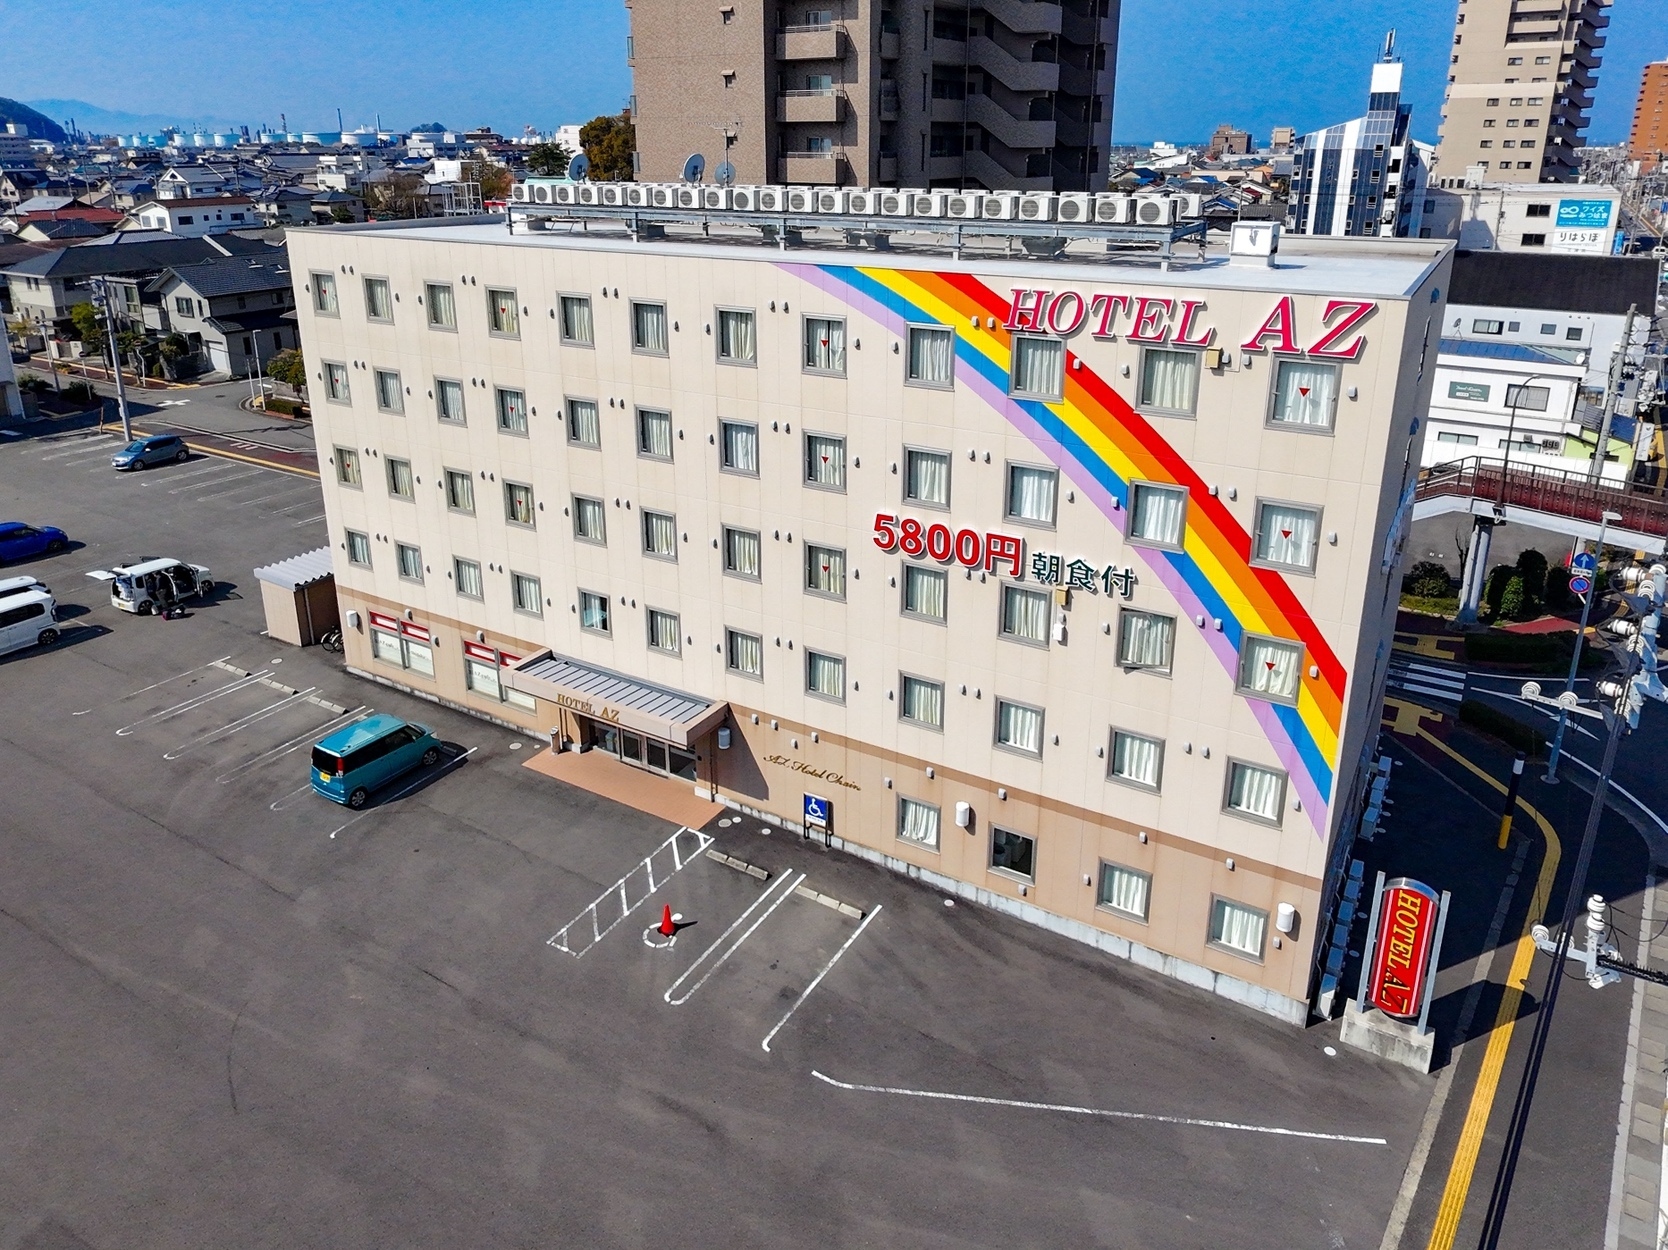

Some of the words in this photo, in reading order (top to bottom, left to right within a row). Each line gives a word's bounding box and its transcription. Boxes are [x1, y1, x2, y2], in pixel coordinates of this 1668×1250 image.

[1560, 232, 1600, 242] りはらぼ
[1002, 288, 1215, 347] HOTEL
[1240, 295, 1376, 359] AZ
[872, 512, 1024, 578] 5800円
[1031, 550, 1136, 598] 朝食付
[557, 693, 595, 715] HOTEL
[600, 706, 620, 723] AZ
[791, 760, 827, 779] Hotel
[826, 772, 862, 791] Chain
[1387, 889, 1421, 969] HOTEL
